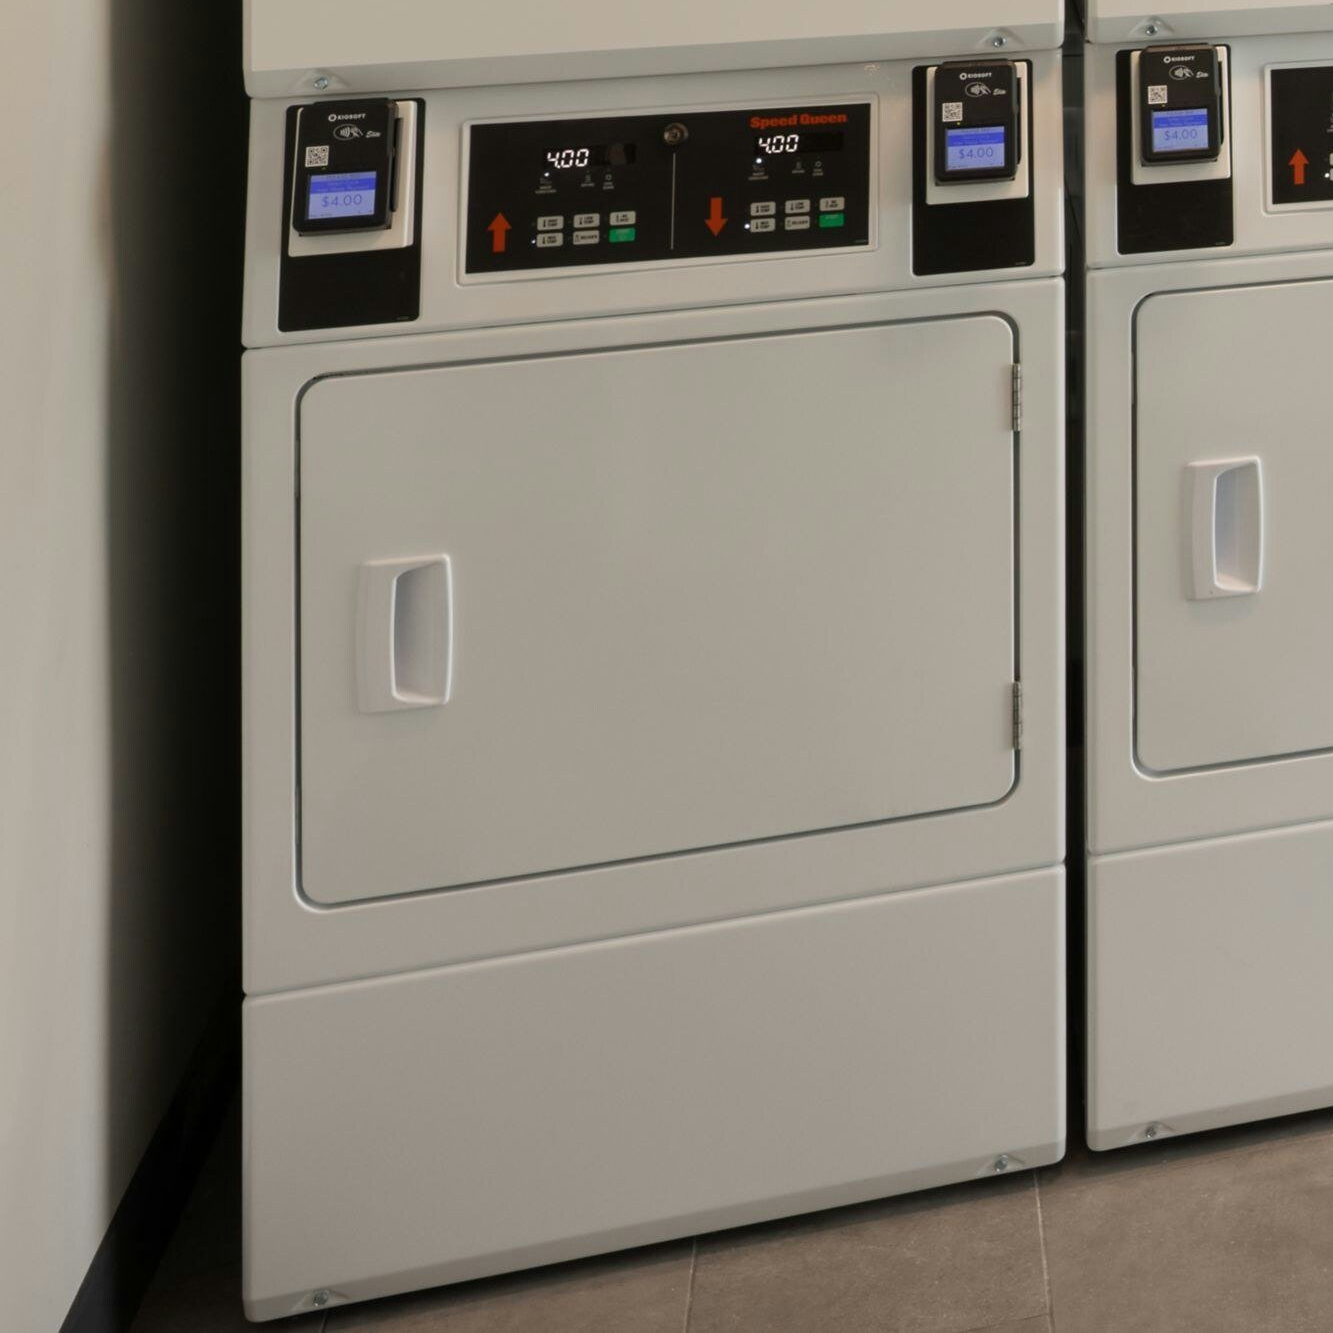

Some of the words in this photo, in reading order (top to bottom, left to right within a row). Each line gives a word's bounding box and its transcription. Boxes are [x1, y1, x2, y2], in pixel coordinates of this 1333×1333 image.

[750, 114, 798, 130] Speed
[799, 112, 848, 126] Queen
[1163, 128, 1198, 140] $4.00
[758, 133, 799, 154] 4.00
[547, 148, 590, 169] 4.00
[959, 146, 994, 159] $4.00
[321, 194, 362, 208] $4.00
